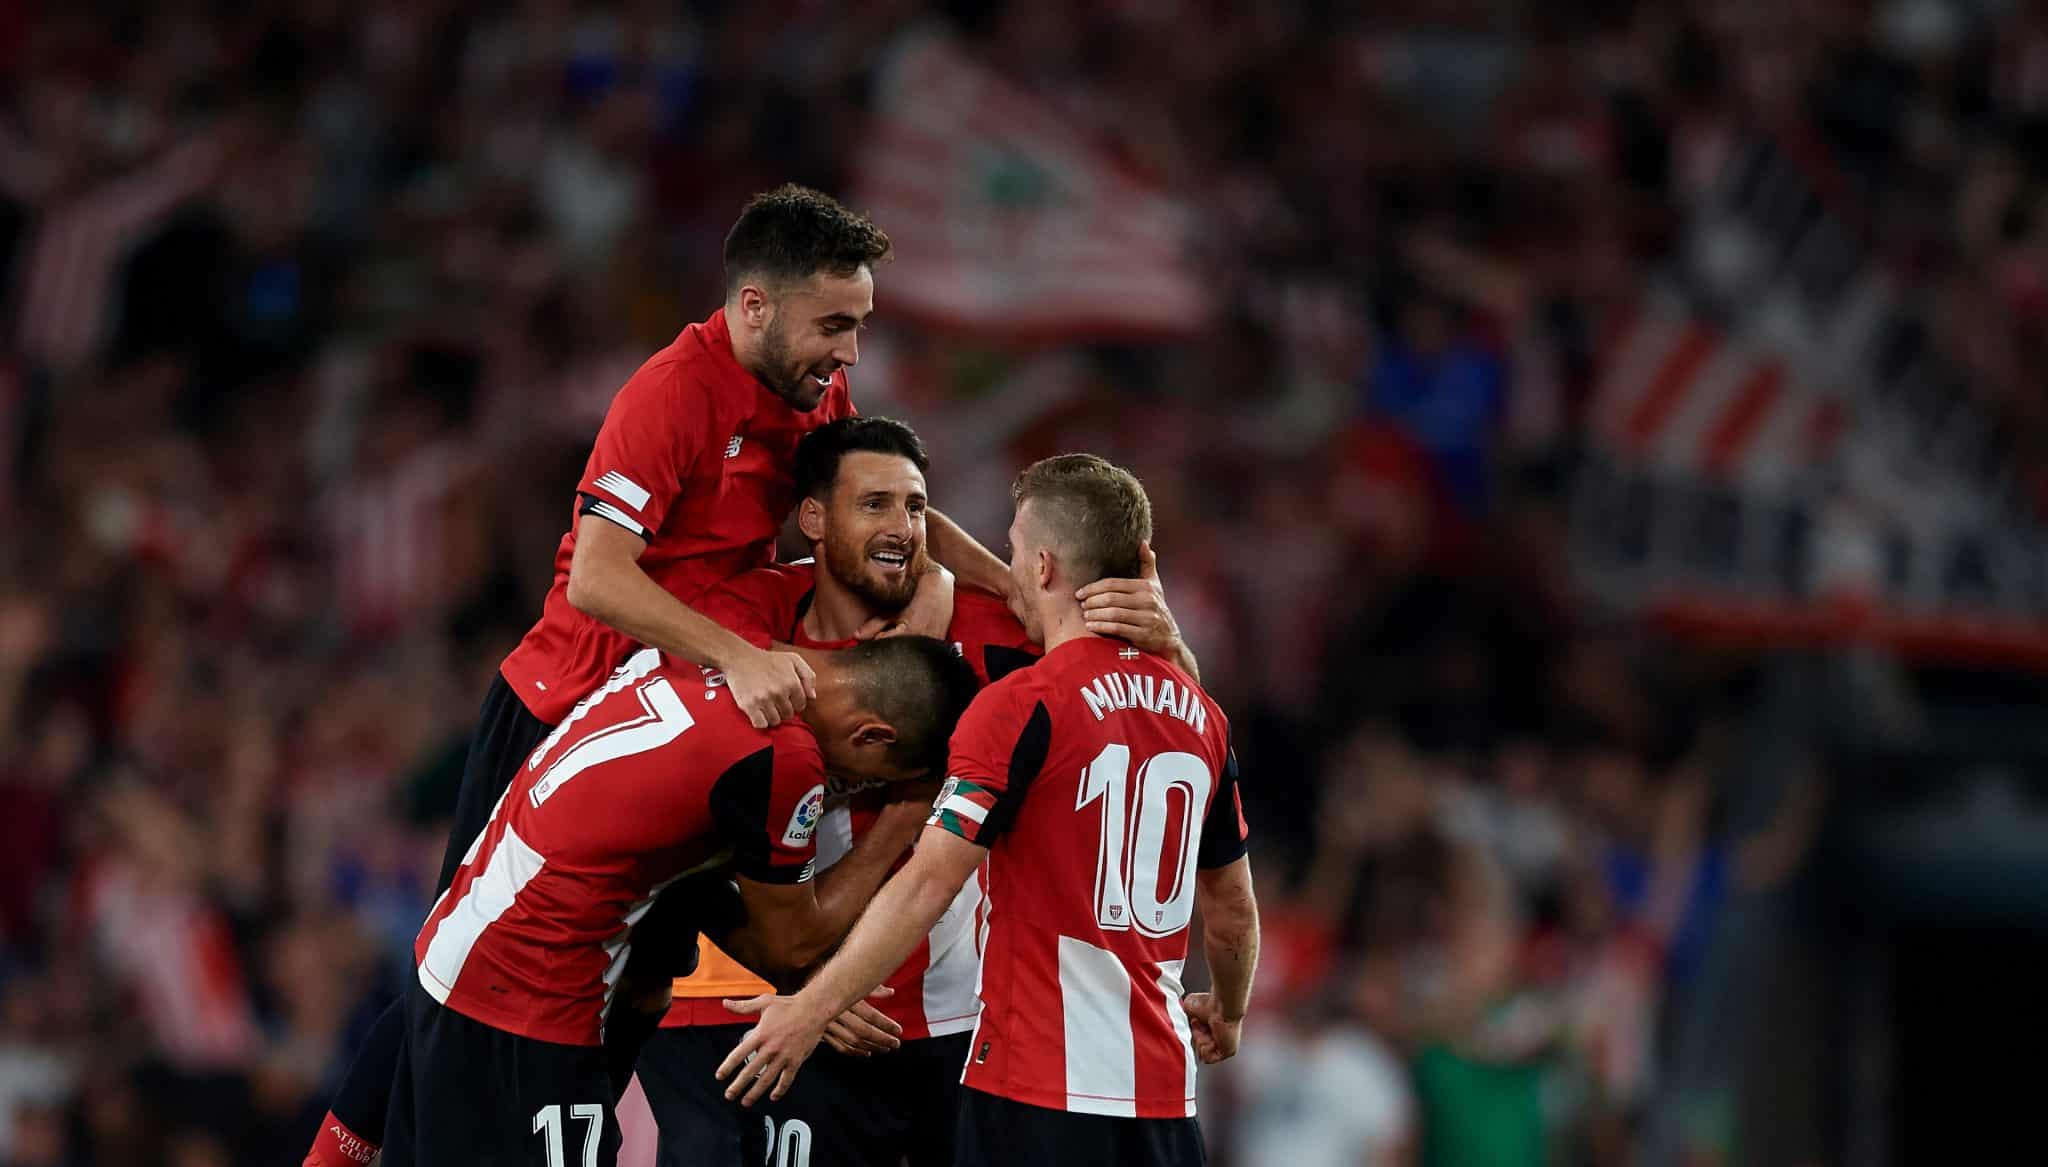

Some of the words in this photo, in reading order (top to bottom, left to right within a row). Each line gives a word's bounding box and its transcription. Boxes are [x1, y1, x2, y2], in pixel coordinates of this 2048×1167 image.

[528, 648, 696, 808] 17
[1080, 671, 1207, 736] MUNAIN
[1074, 743, 1212, 938] 10
[532, 1103, 603, 1167] 17
